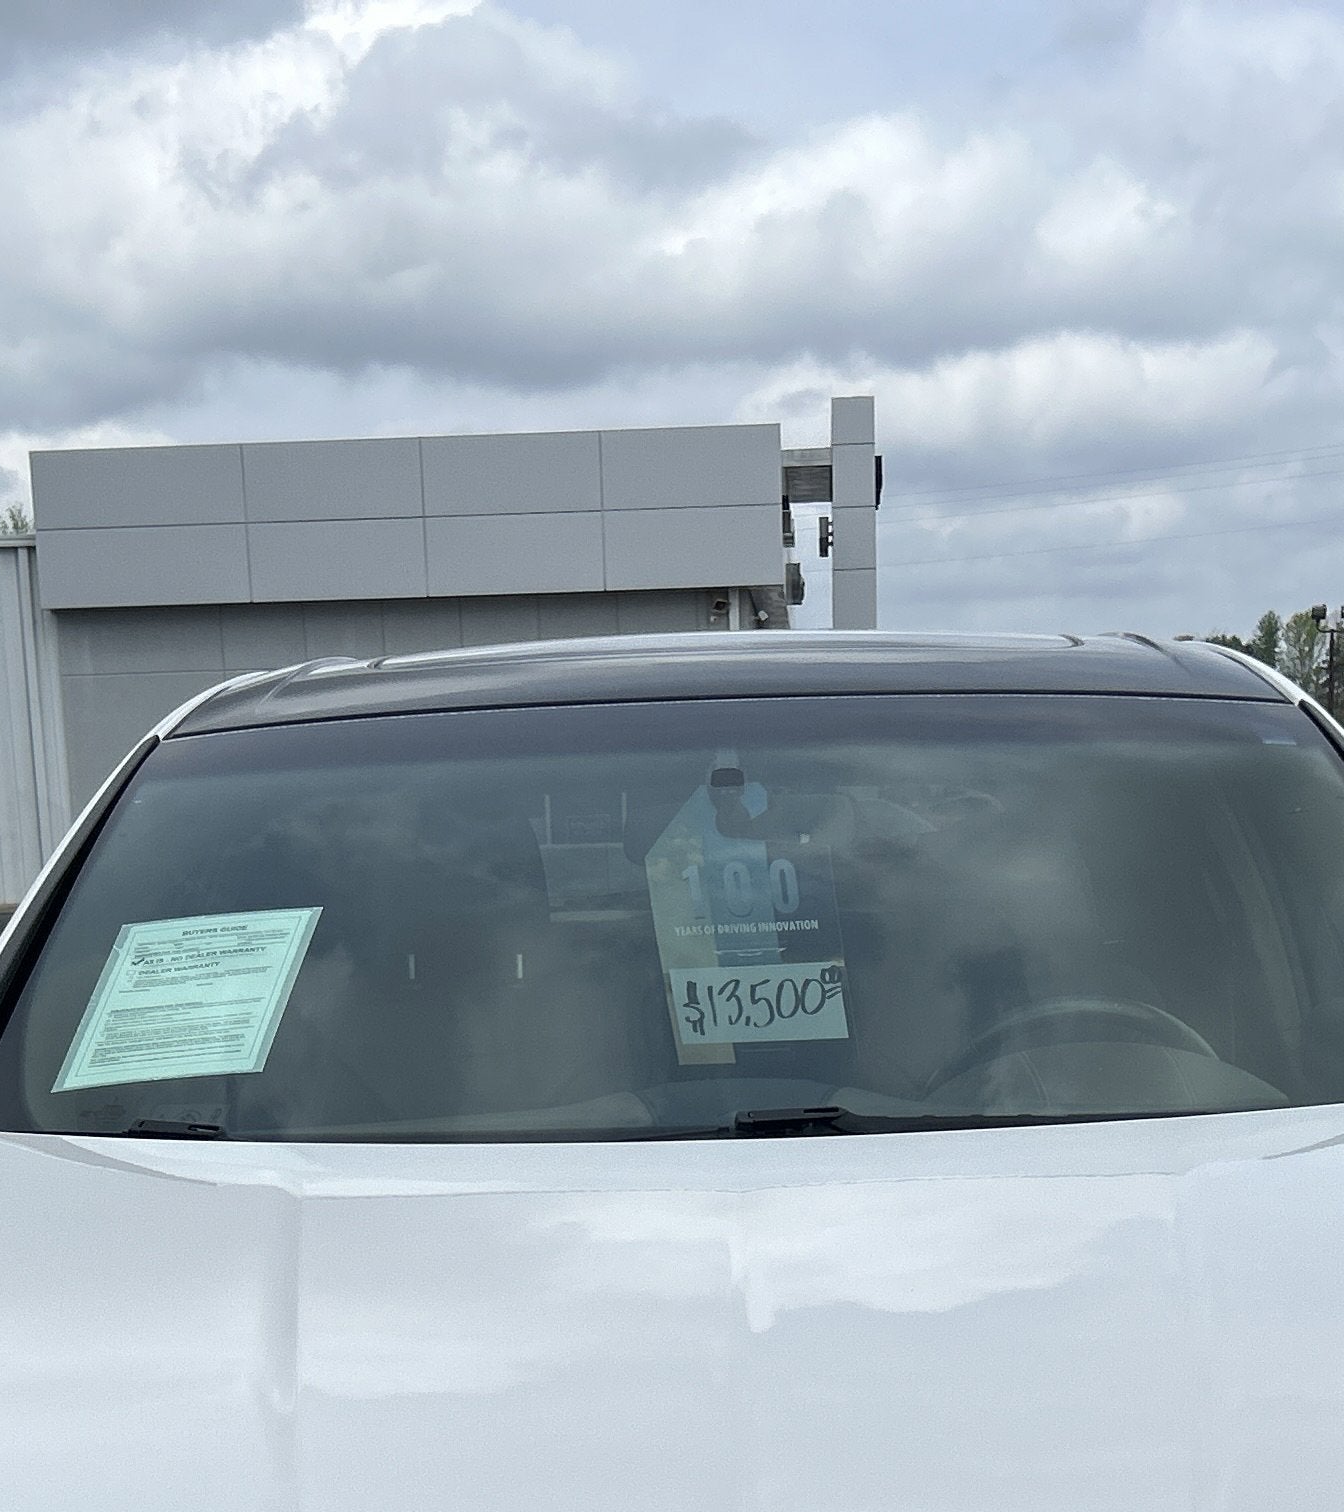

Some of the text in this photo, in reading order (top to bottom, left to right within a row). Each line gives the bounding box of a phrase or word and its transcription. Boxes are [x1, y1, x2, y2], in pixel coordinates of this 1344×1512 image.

[676, 920, 819, 936] YEARS OF DRIVING INNOVATION
[185, 951, 217, 960] DEALER
[219, 946, 267, 955] WARRANTY
[174, 962, 221, 971] WARRANTY
